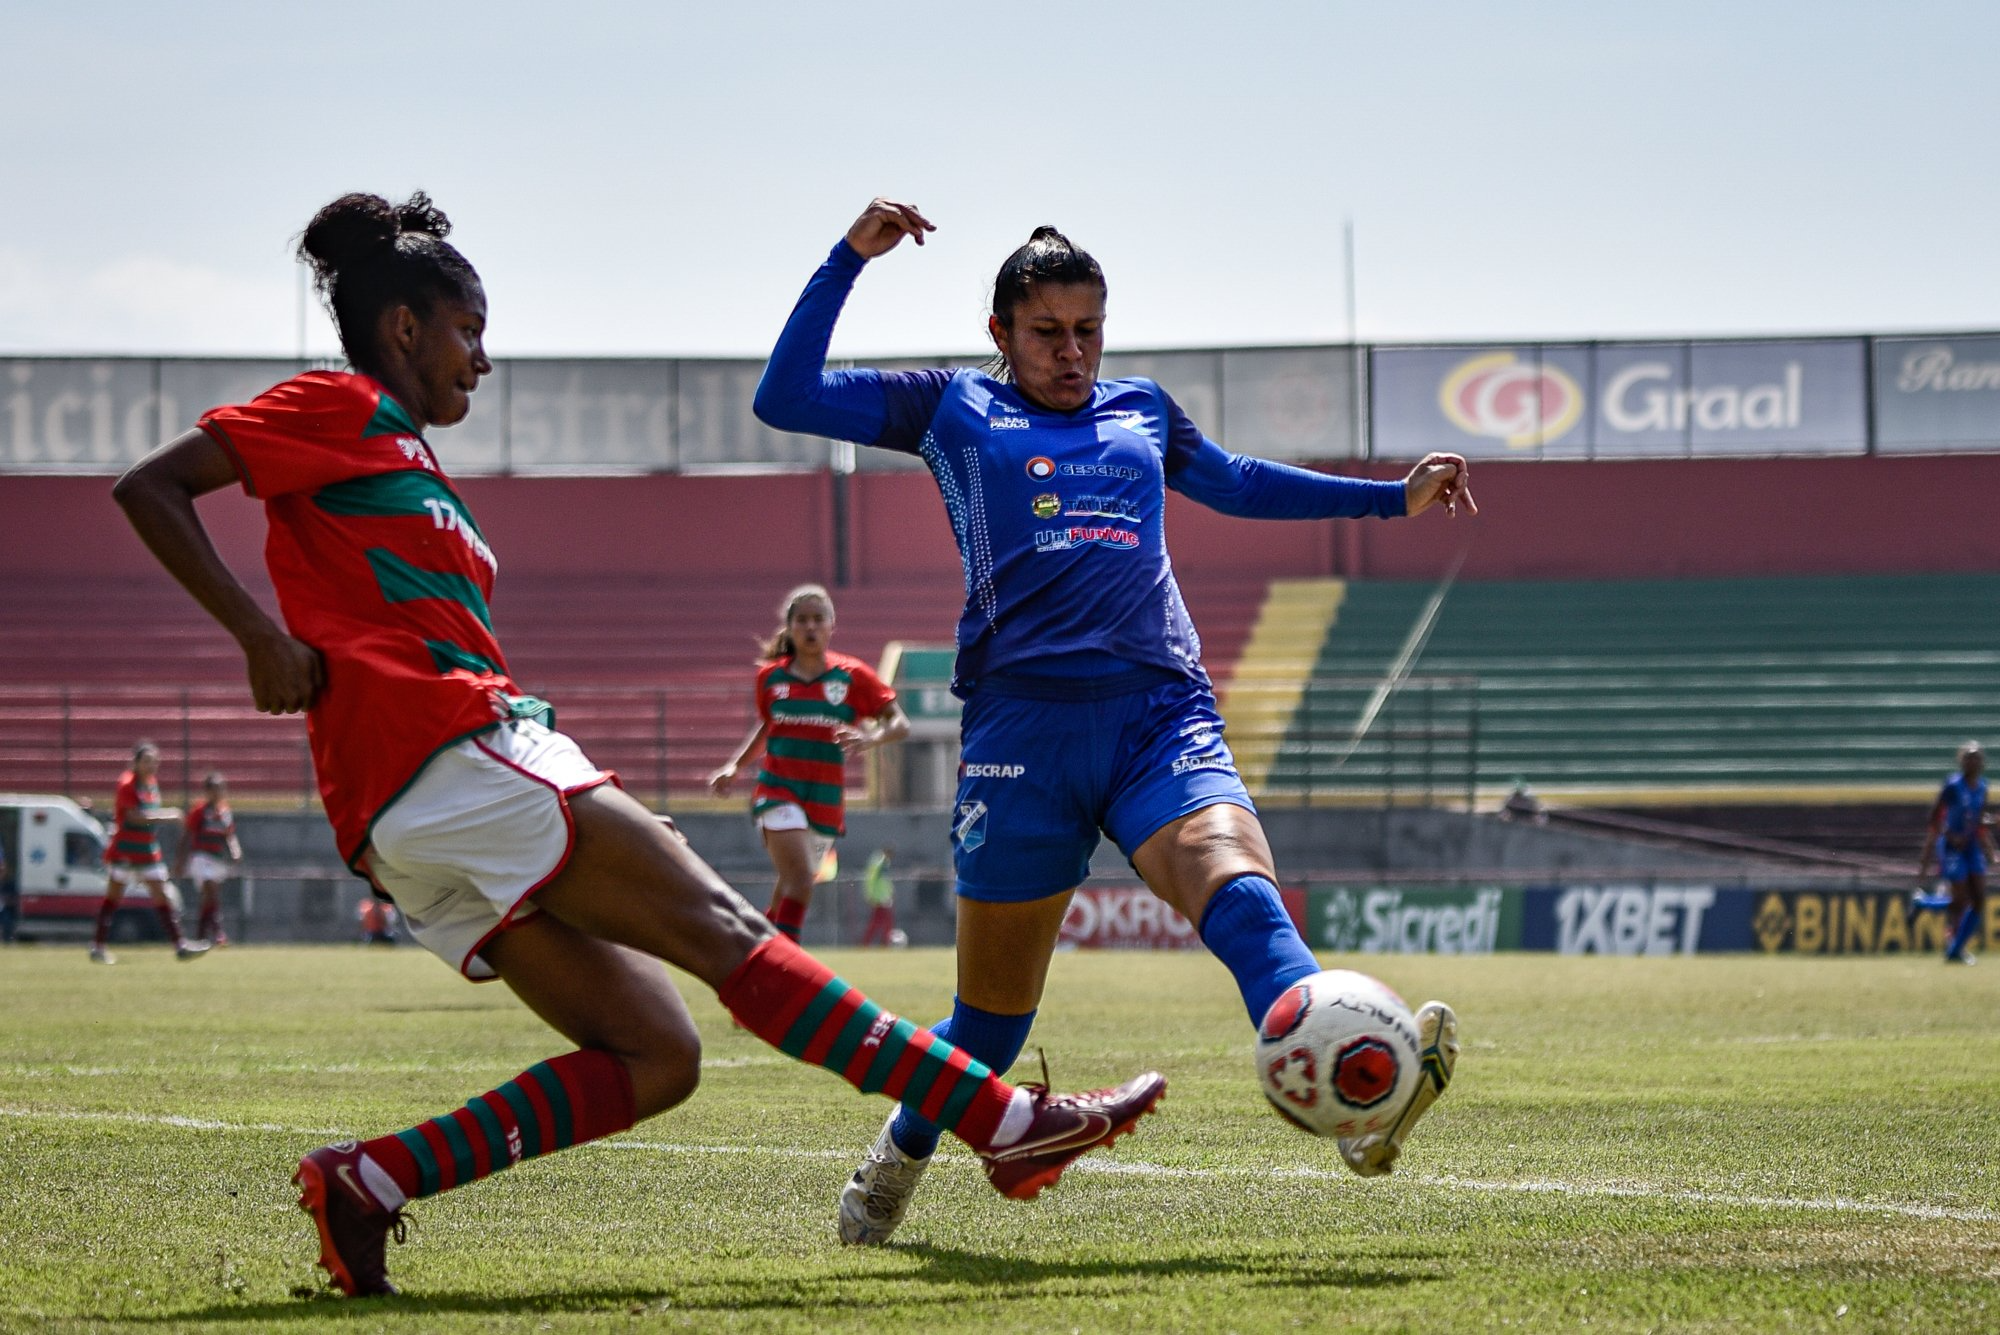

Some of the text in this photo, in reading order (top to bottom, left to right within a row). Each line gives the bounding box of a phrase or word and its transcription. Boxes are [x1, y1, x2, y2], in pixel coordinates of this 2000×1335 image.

[1604, 363, 1801, 432] Graal
[1059, 463, 1142, 481] GESCRAP
[1363, 889, 1502, 955] Sicredi
[1557, 887, 1715, 956] 1XBET
